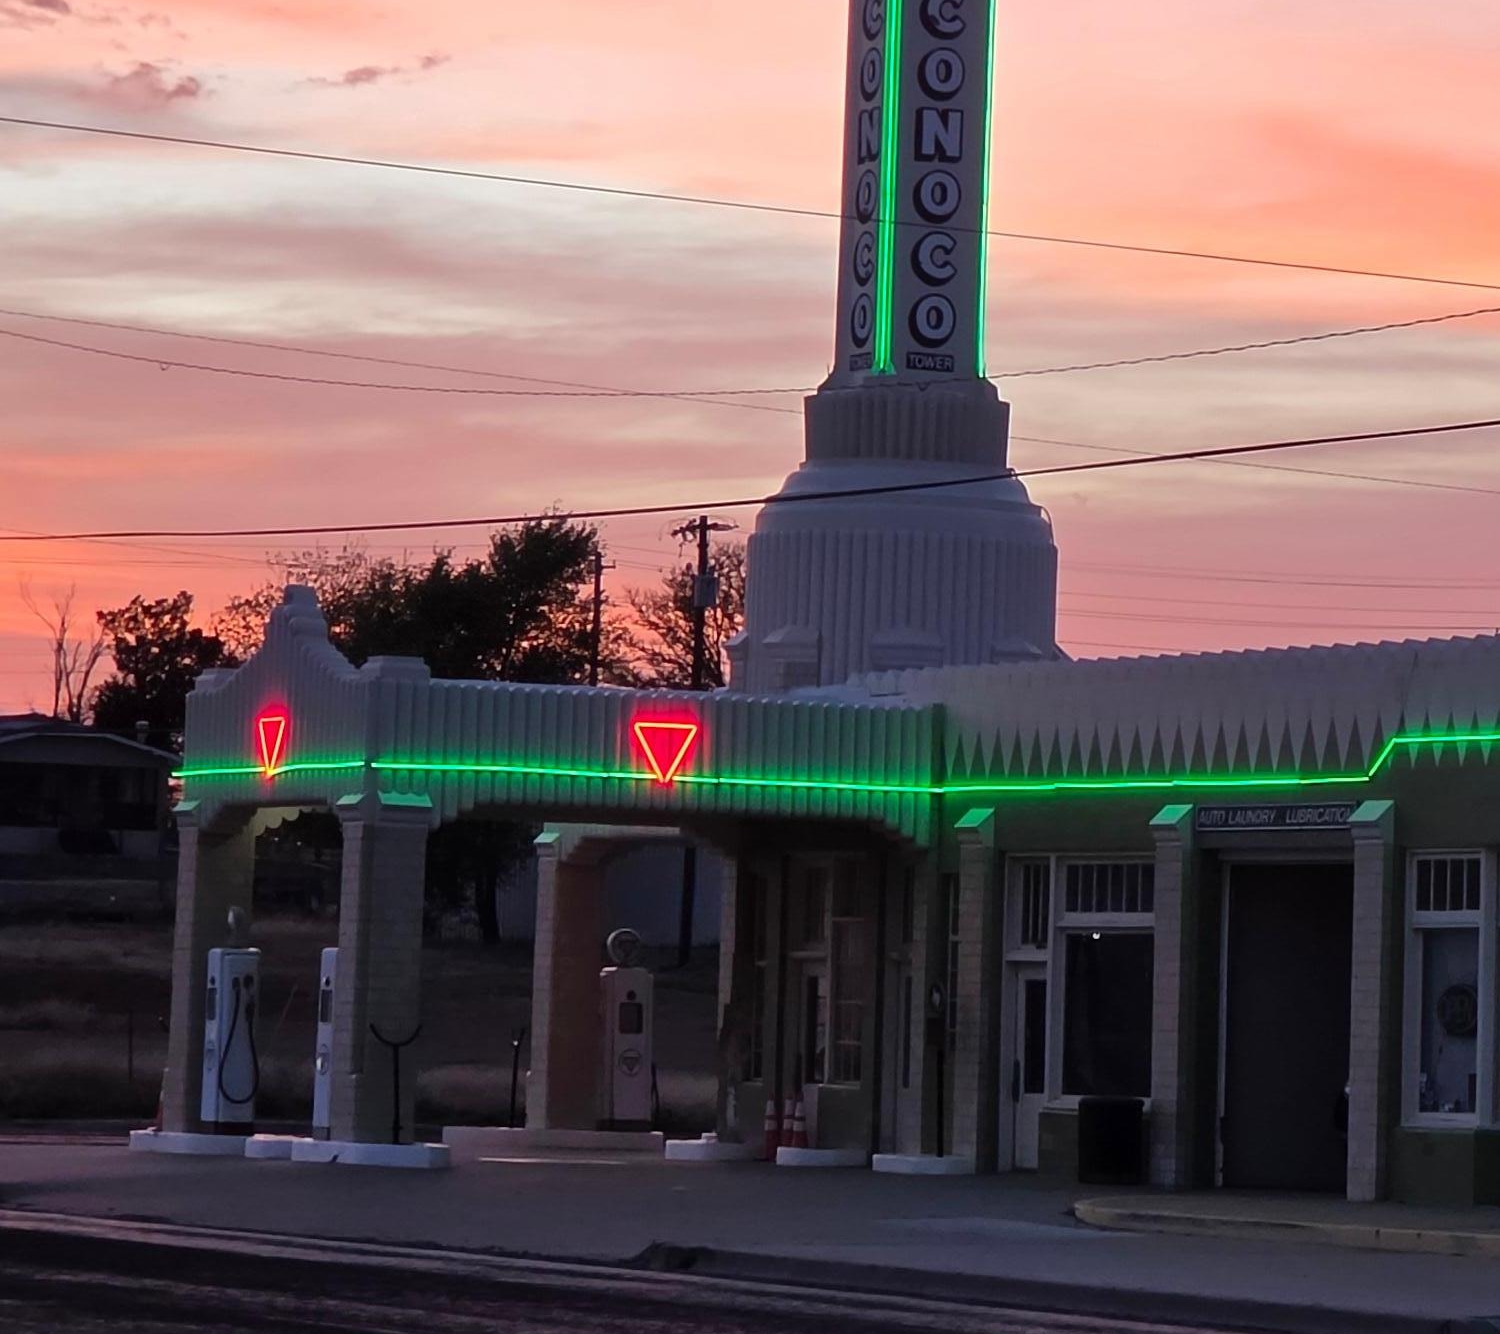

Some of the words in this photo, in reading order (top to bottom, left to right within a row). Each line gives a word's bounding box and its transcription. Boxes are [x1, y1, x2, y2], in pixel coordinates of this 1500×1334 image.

[908, 353, 953, 371] TOWER
[1200, 810, 1226, 826] AUTO
[1228, 808, 1277, 825] LAUNDRY
